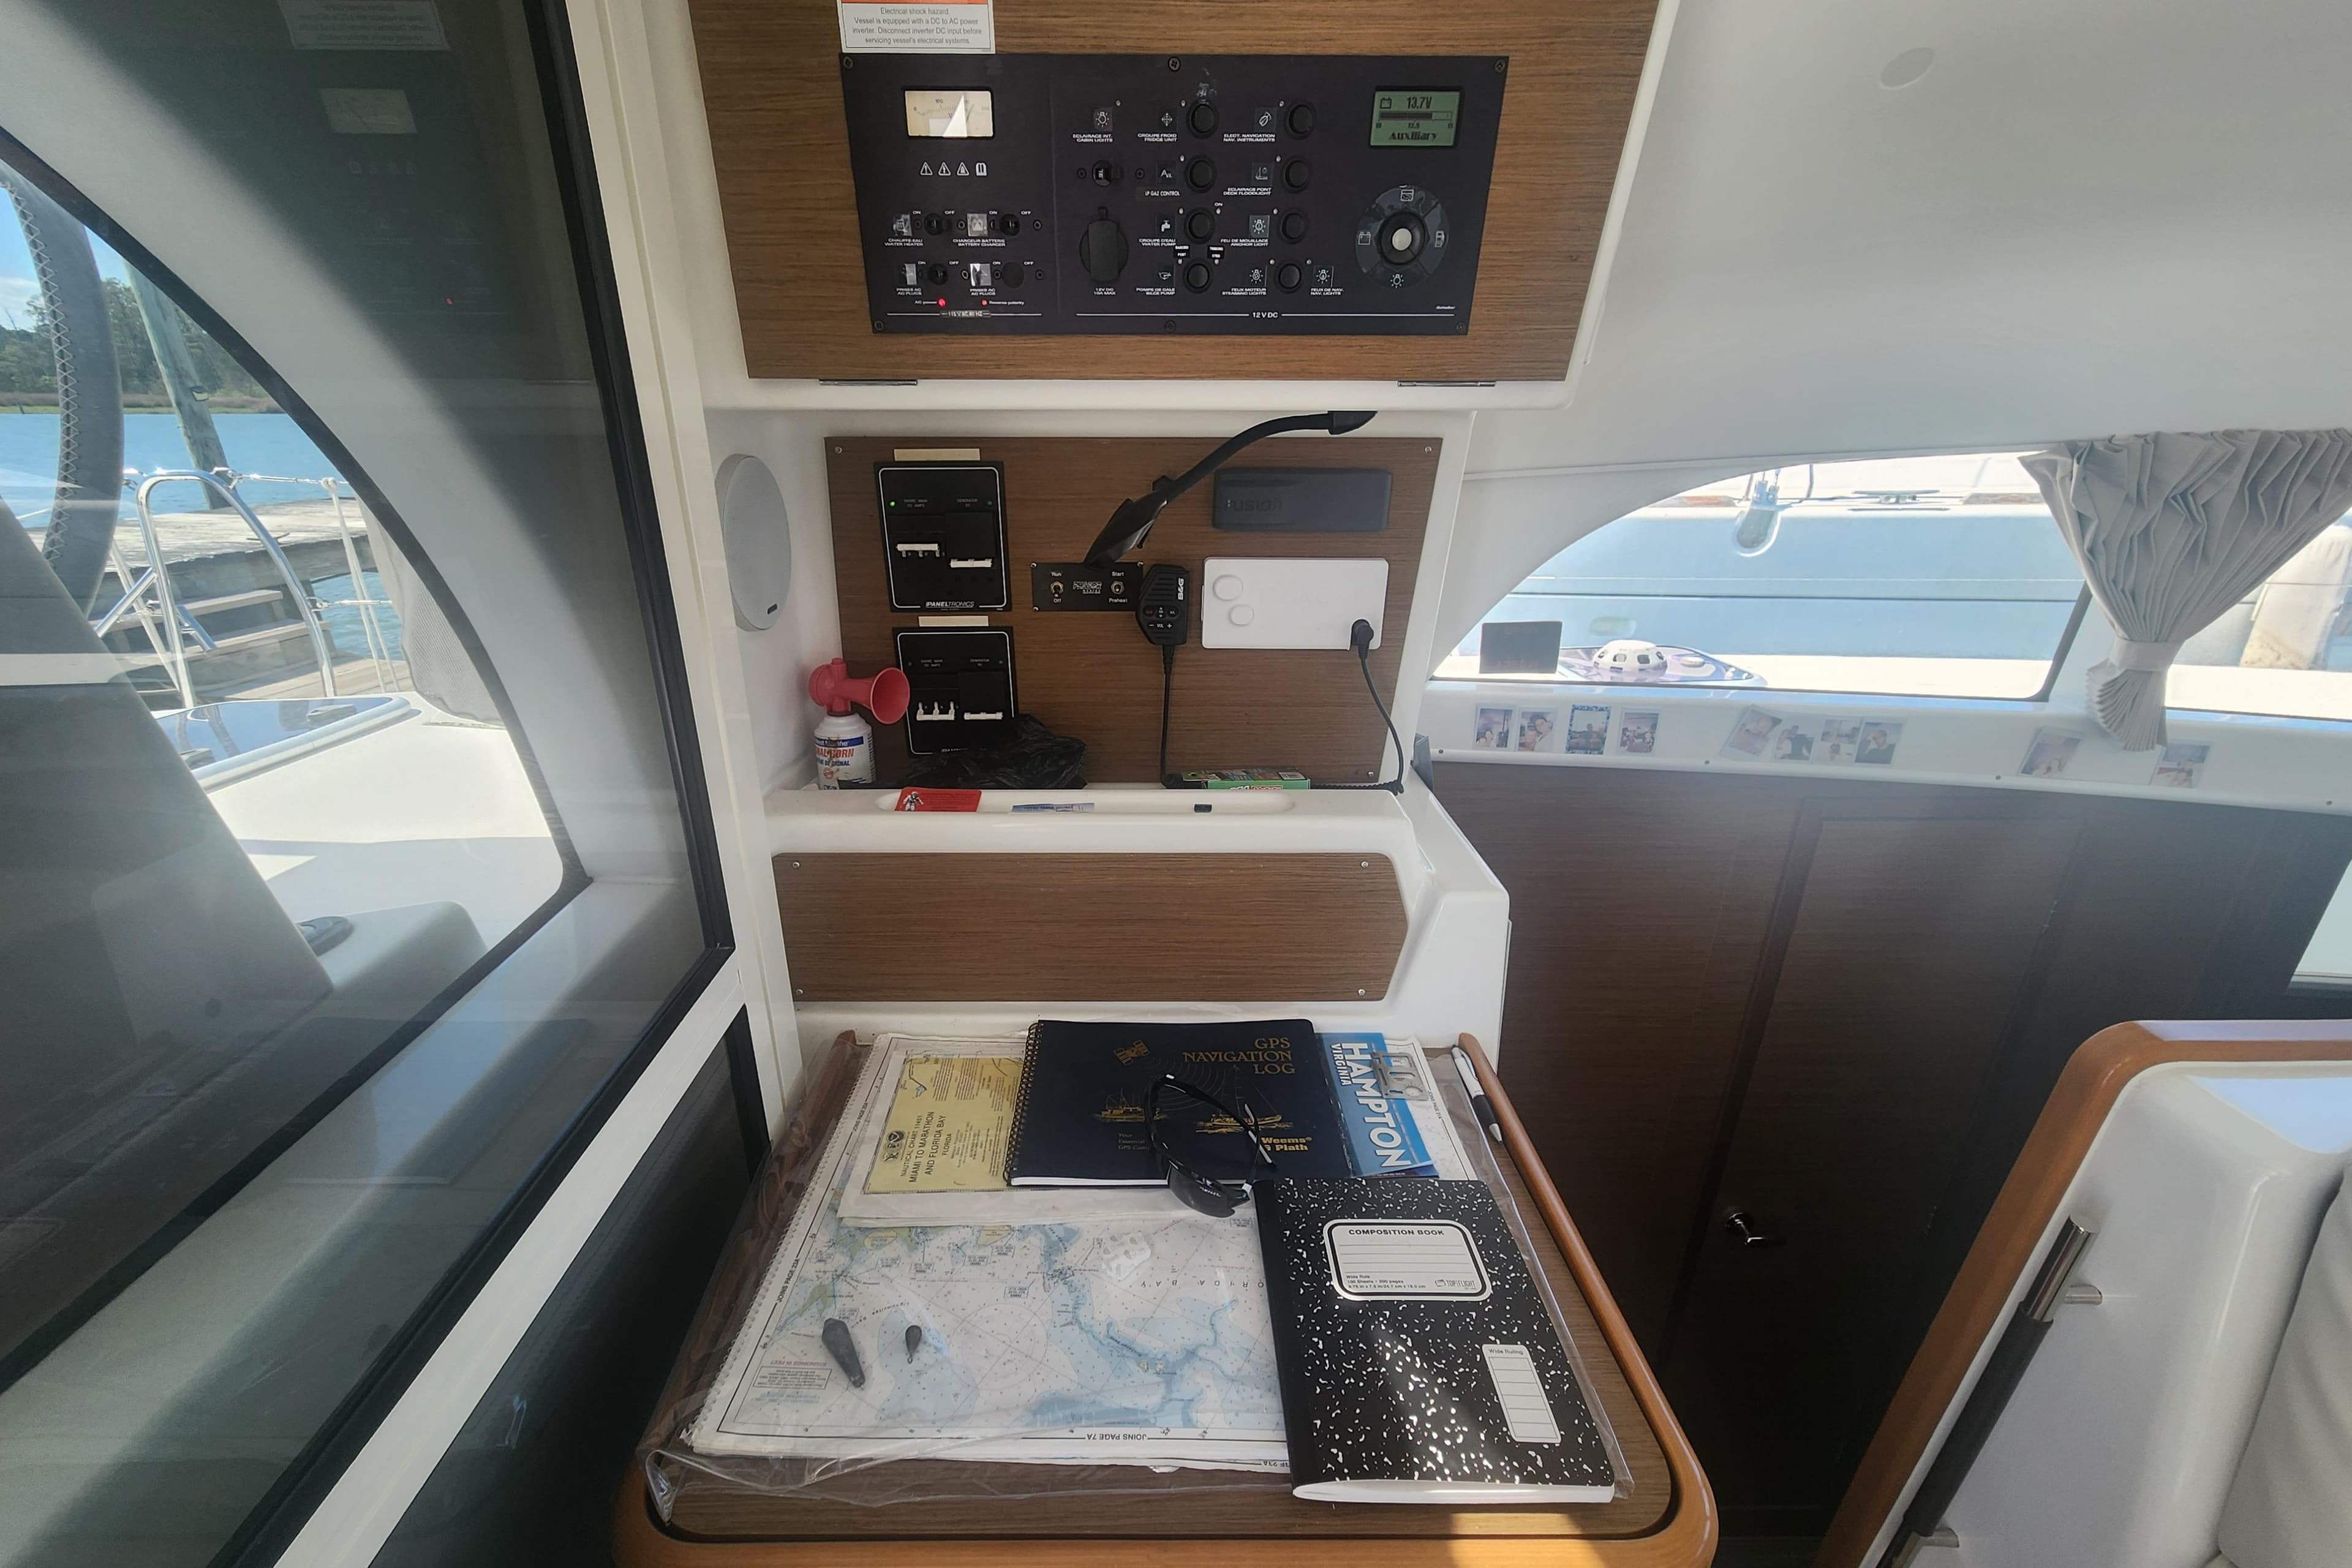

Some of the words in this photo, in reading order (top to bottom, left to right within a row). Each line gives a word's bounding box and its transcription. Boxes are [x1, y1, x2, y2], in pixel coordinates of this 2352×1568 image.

[1407, 96, 1432, 109] 13.7V
[1389, 131, 1438, 141] Auxiliary
[1254, 1038, 1291, 1050] GPS
[1182, 1050, 1292, 1064] NAVIGATION
[1330, 1042, 1352, 1087] VIRGINIA
[1254, 1063, 1295, 1074] LOG
[1341, 1042, 1412, 1167] HAMPTON
[919, 1112, 935, 1148] MARATHON
[937, 1115, 946, 1128] BAY
[929, 1129, 943, 1158] FLORIDA
[941, 1133, 952, 1156] FLORIDA
[901, 1150, 914, 1177] NAUTICAL
[908, 1130, 918, 1148] CHART
[915, 1149, 925, 1159] TO
[909, 1161, 922, 1183] MIAMI
[924, 1160, 935, 1175] AND
[777, 1286, 788, 1303] JOINS
[784, 1270, 796, 1284] PAGE
